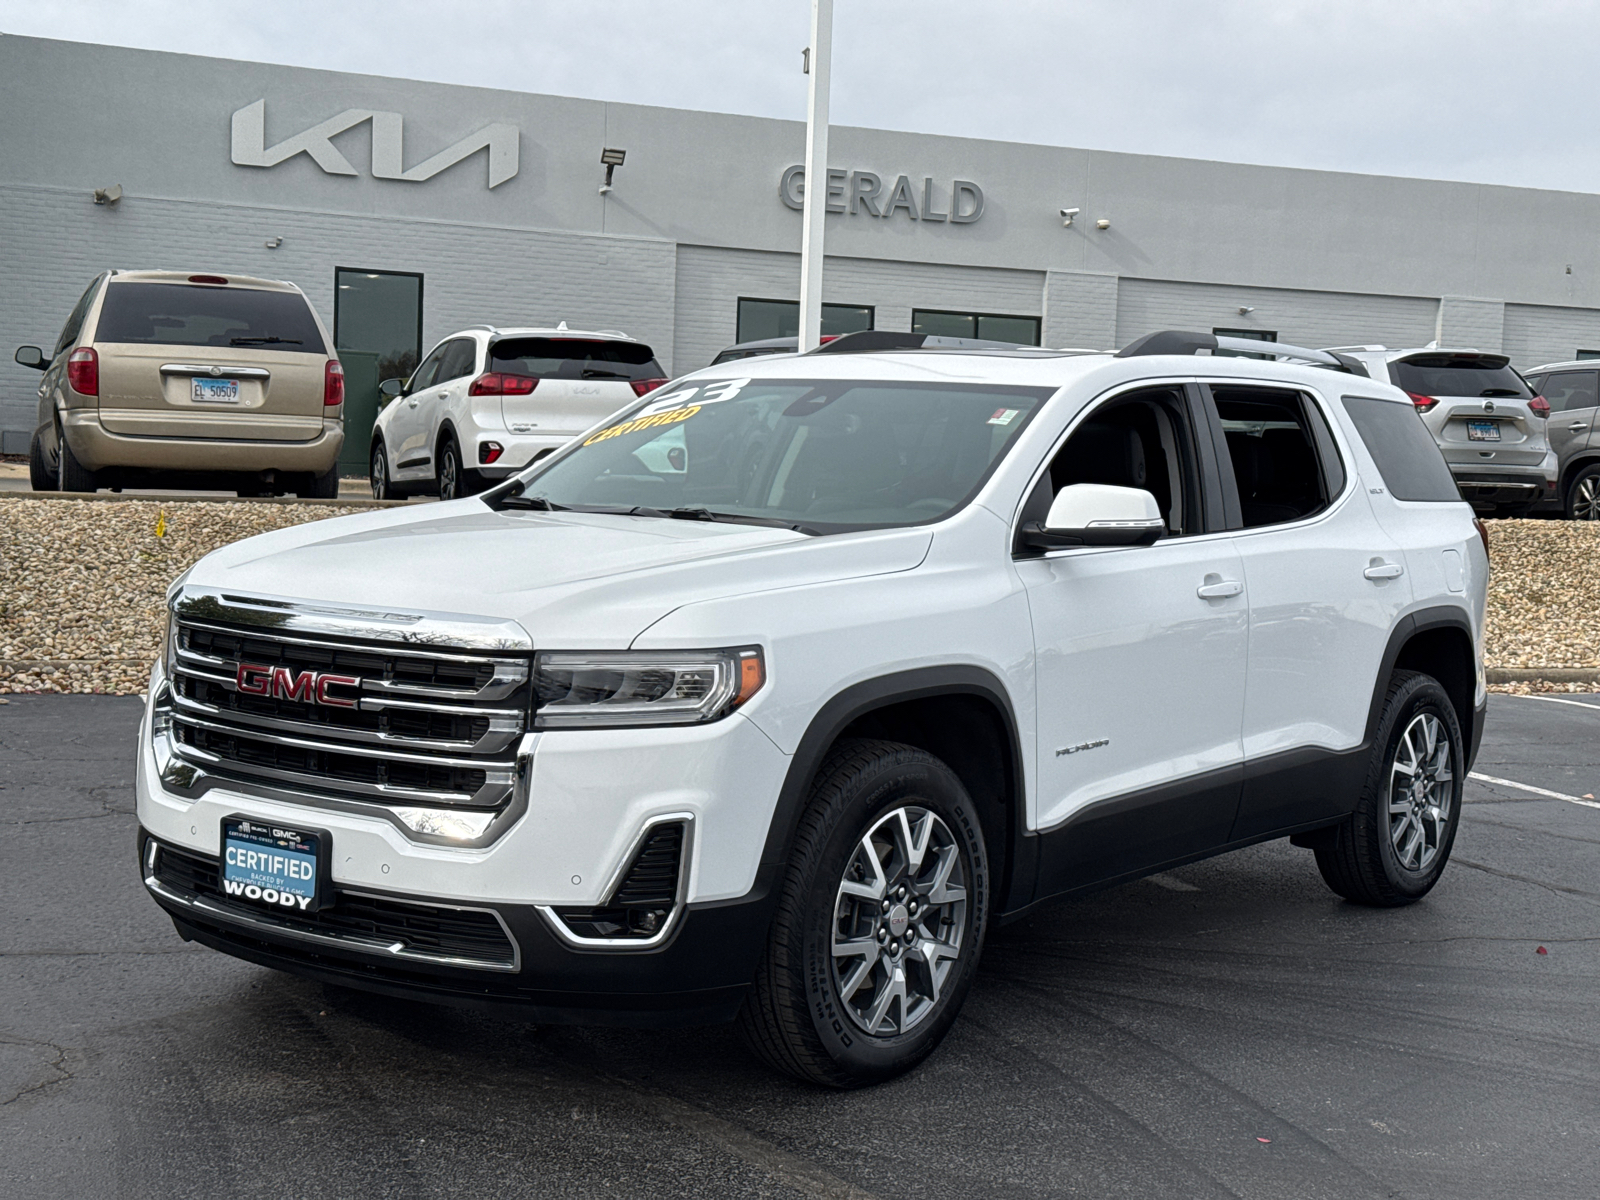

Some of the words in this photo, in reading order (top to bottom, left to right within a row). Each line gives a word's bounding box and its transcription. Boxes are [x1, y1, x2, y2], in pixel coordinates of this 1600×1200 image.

[231, 98, 520, 189] KIA
[779, 164, 985, 224] GERALD
[194, 384, 205, 397] EL
[210, 385, 237, 398] 50509
[633, 377, 752, 420] 23
[582, 405, 702, 447] CERTIFIED
[237, 664, 361, 711] GMC
[1055, 738, 1110, 757] ACADIA
[229, 831, 249, 839] CERTIFIED
[272, 828, 297, 840] GMC
[225, 846, 313, 881] CERTIFIED
[250, 872, 275, 883] BACKED
[275, 878, 285, 886] BY
[223, 879, 312, 910] WOODY
[266, 883, 284, 892] BUICK
[290, 887, 305, 896] GMC
